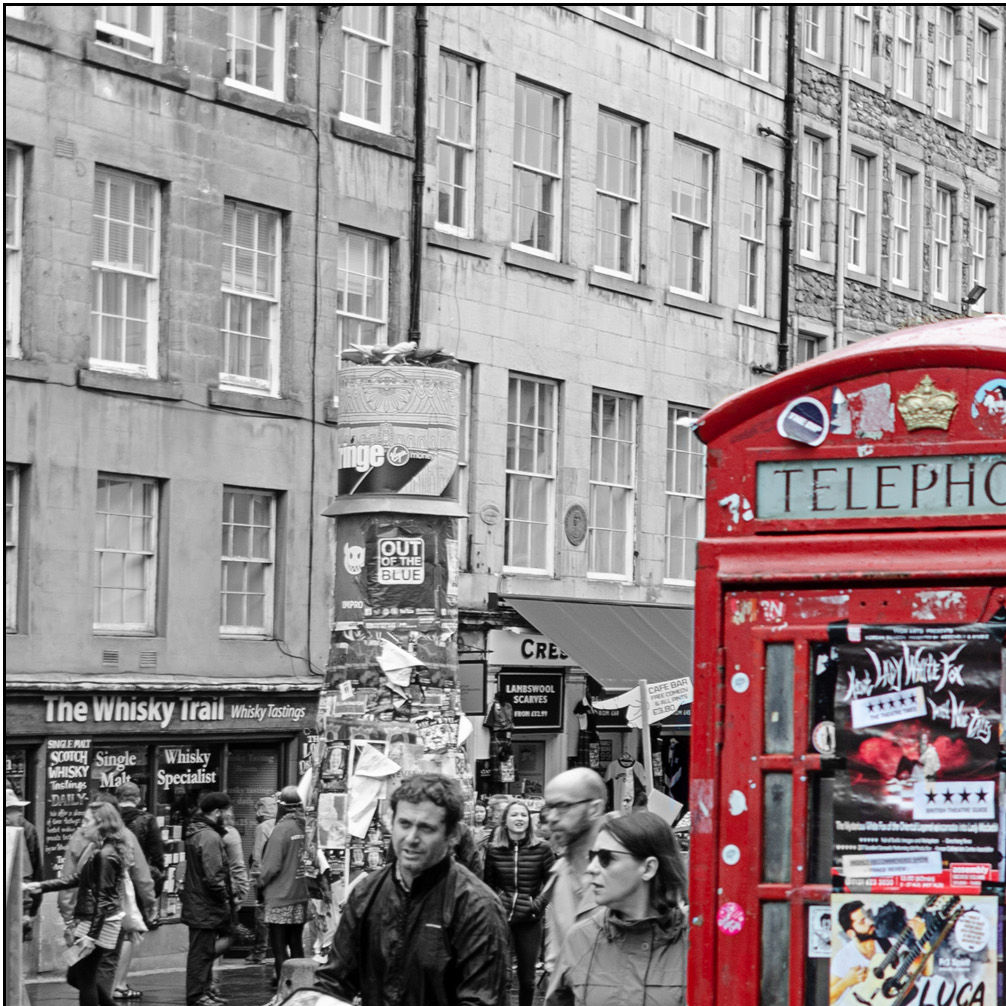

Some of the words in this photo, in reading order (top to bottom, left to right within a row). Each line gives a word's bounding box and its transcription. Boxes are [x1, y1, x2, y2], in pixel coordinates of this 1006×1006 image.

[381, 541, 421, 557] OUT
[381, 556, 397, 566] OF
[400, 557, 422, 566] THE
[381, 569, 421, 581] BLUE
[506, 684, 555, 693] LAMBSWOOL
[648, 683, 669, 694] CAFE
[670, 679, 688, 690] BAR
[513, 695, 548, 704] SCARVES
[44, 696, 88, 723] The
[93, 696, 175, 728] Whisky
[180, 696, 225, 722] Trail
[231, 704, 266, 722] Whisky
[267, 703, 307, 721] Tastings
[514, 710, 530, 718] FROM
[47, 739, 72, 749] SINGLE
[50, 750, 88, 766] SCOTCH
[95, 751, 137, 773] Single
[164, 748, 212, 768] Whisky
[48, 765, 90, 779] WHISKY
[100, 770, 132, 788] Malt
[157, 768, 217, 791] Specialist
